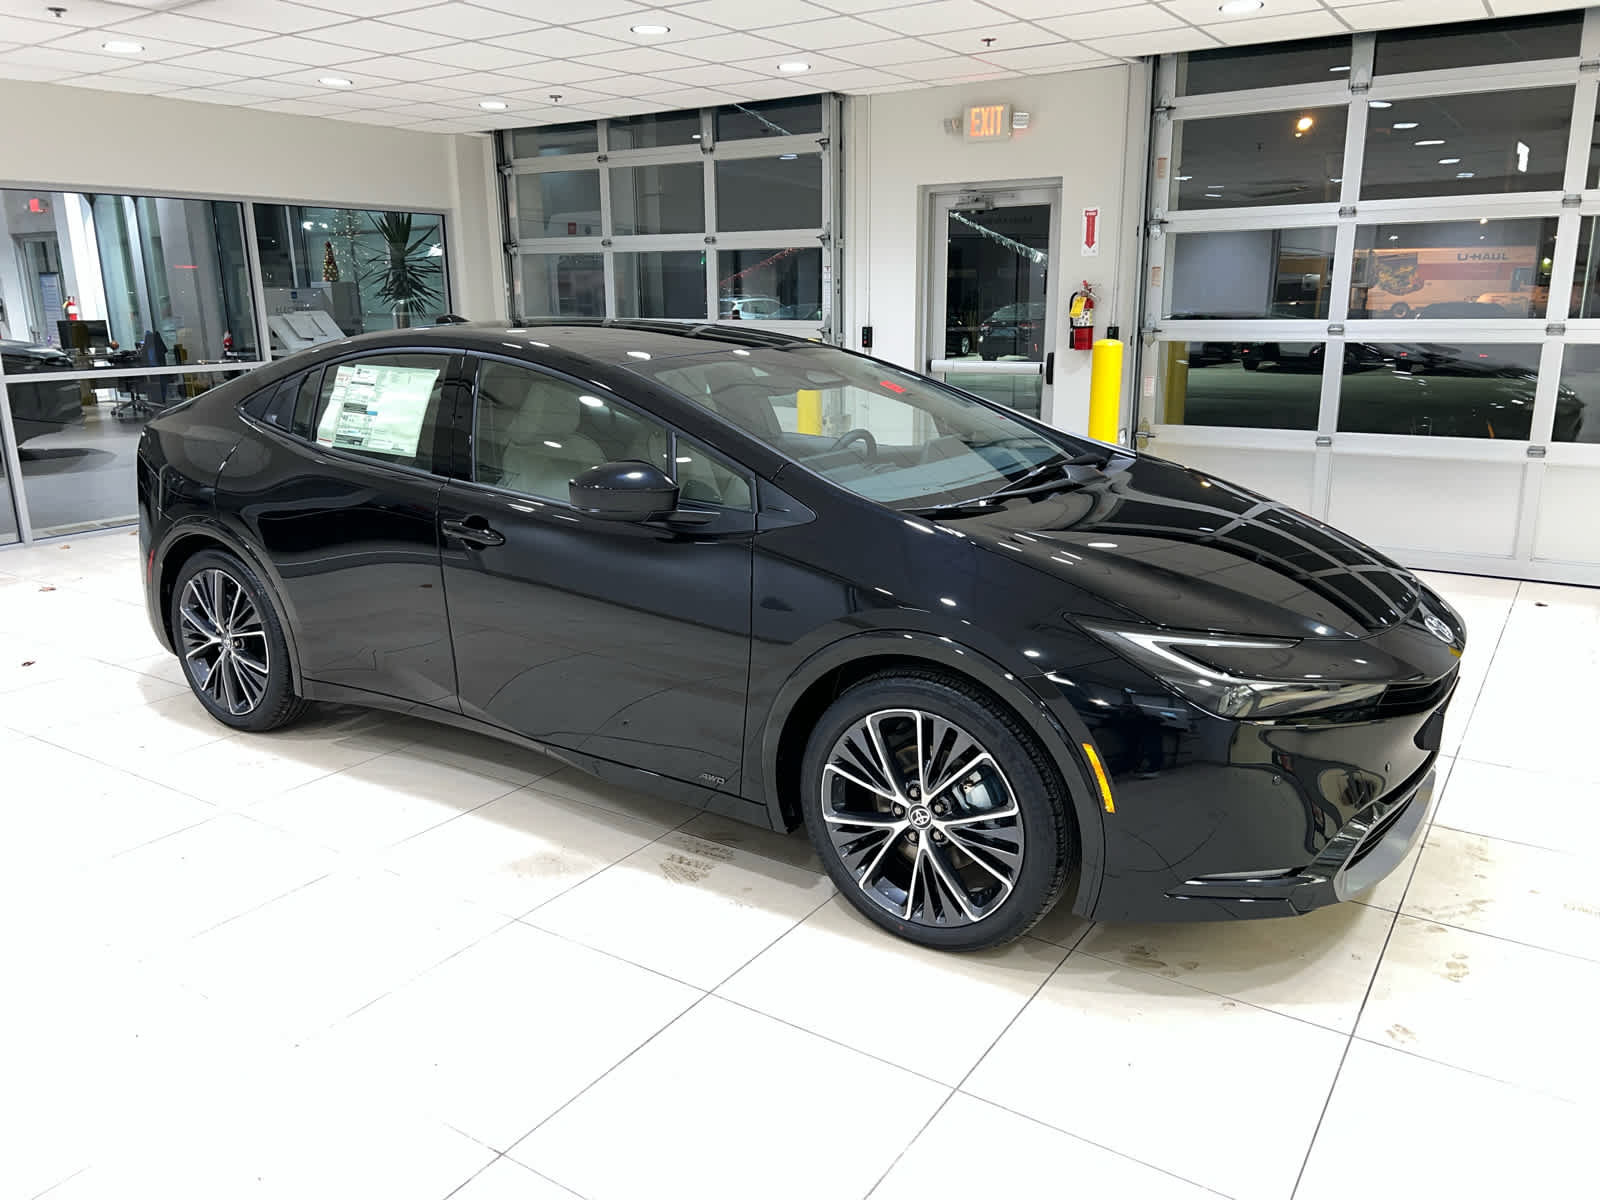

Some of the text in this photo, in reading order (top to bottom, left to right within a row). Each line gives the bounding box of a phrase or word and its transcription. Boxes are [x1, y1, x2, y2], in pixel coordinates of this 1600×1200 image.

[970, 106, 1004, 136] EXIT
[1457, 253, 1508, 261] U-HAUL
[699, 773, 725, 785] AWD
